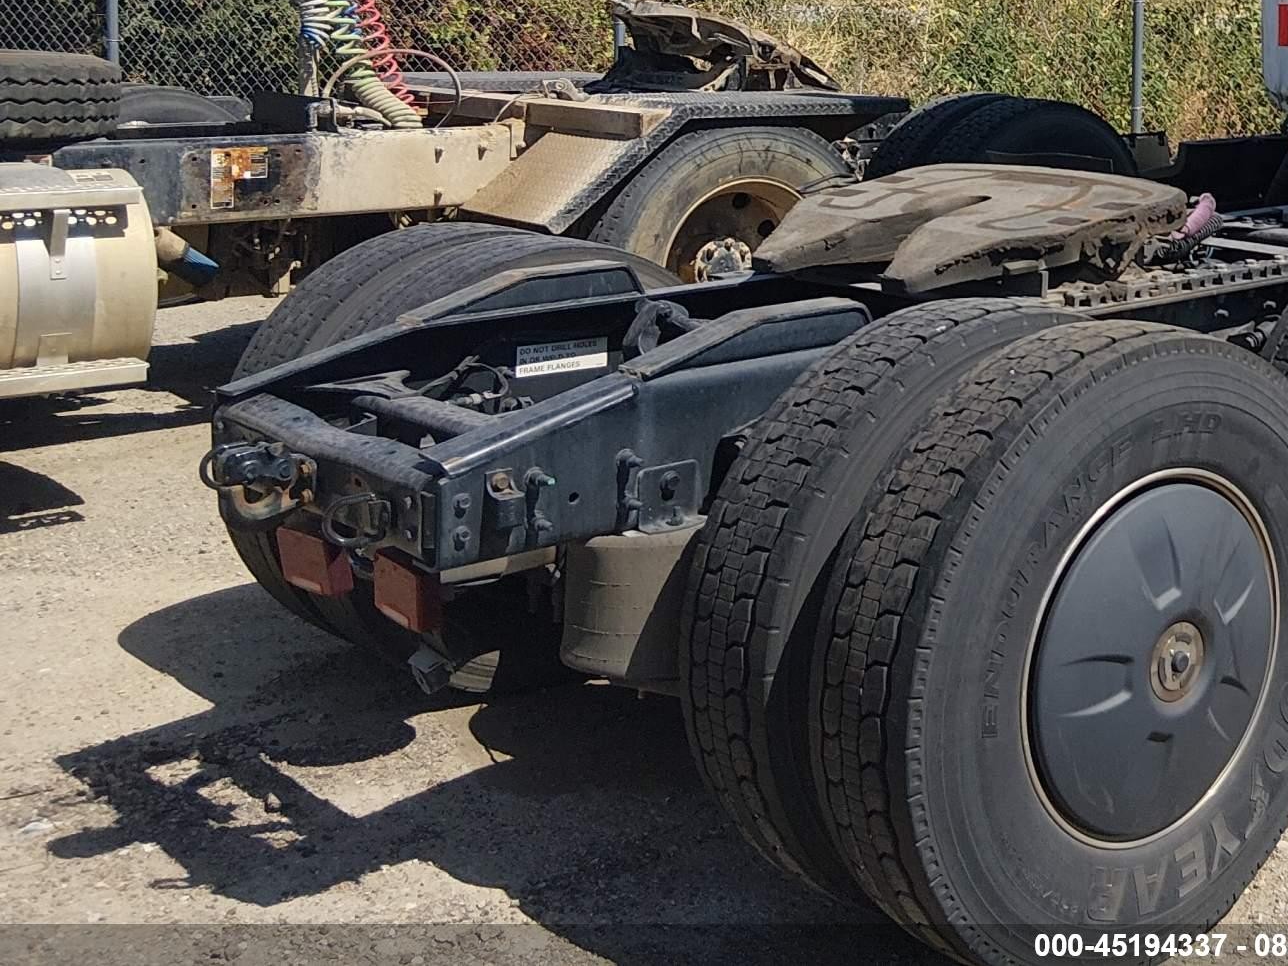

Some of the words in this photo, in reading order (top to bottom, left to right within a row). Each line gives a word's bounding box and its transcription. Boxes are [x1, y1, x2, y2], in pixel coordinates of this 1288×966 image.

[519, 347, 531, 355] DO
[533, 345, 549, 353] NOT
[519, 365, 545, 375] FRAME
[547, 360, 581, 372] FLANGES
[980, 438, 1133, 739] ENDURANCE
